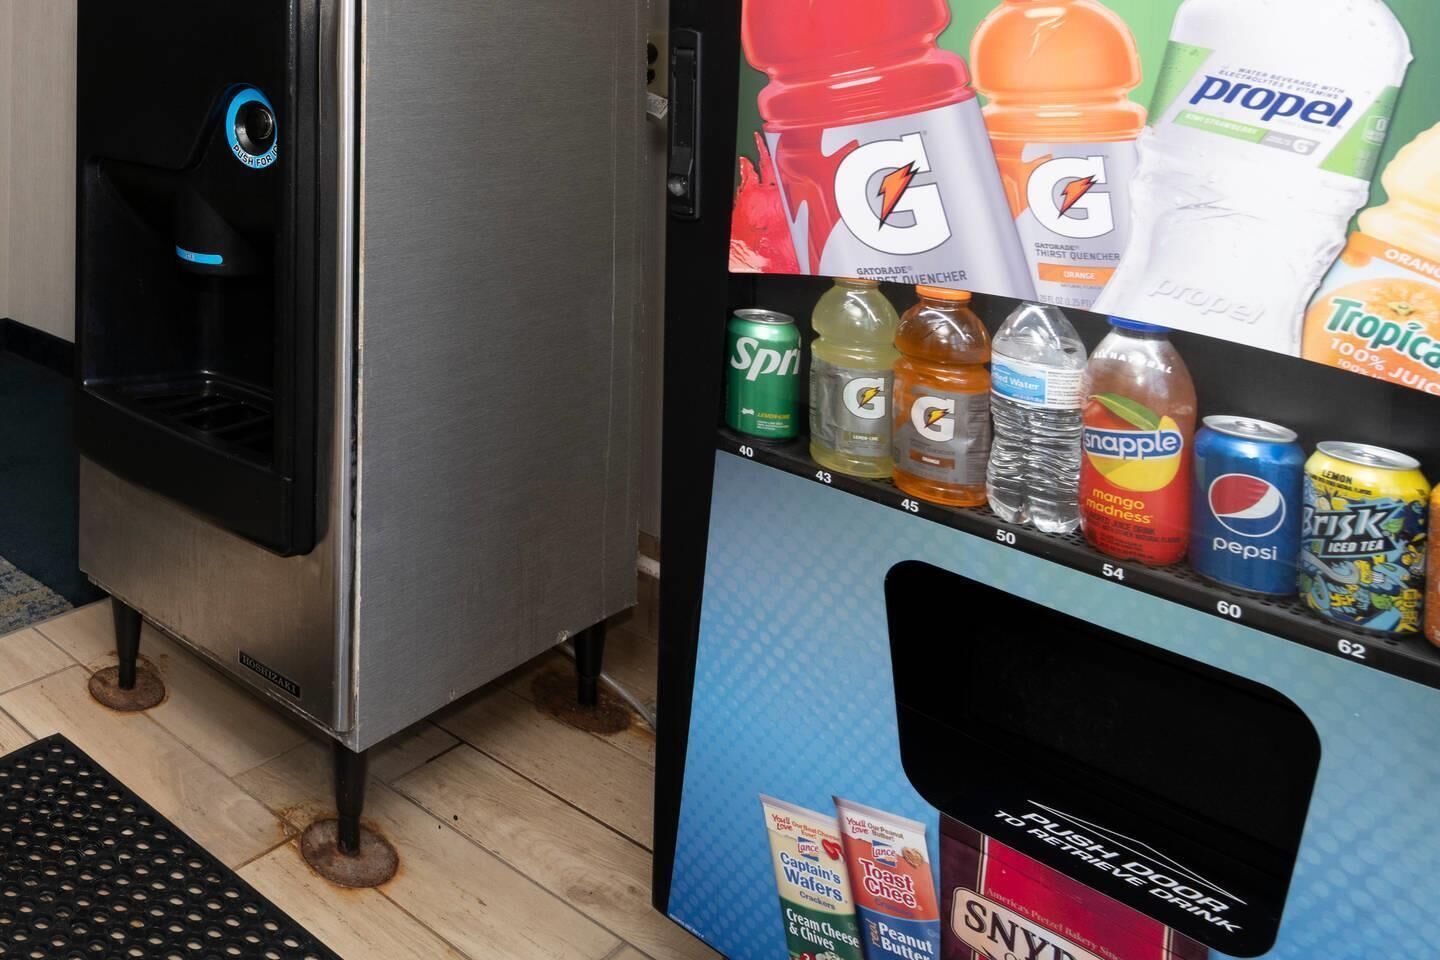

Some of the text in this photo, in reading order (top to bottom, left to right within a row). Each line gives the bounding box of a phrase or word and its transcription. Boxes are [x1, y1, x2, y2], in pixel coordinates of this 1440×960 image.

[1218, 69, 1286, 89] ELECTROLYTES
[1295, 86, 1339, 100] VITAMINS
[1238, 67, 1345, 93] WATER BEVERAGE WITH
[1189, 75, 1353, 128] propel
[233, 144, 272, 167] PUSH FOR
[835, 132, 952, 255] G
[1026, 155, 1115, 239] G
[1034, 242, 1075, 251] GATORADE
[1036, 249, 1120, 261] THIRST QUENCHER
[856, 266, 908, 276] GATORADE
[903, 270, 968, 284] QUENCHER
[1064, 271, 1095, 280] ORANGE
[1147, 280, 1266, 325] propel
[1327, 298, 1440, 369] Tropica
[730, 336, 800, 381] Spri
[1109, 351, 1172, 374] NARAL
[1331, 338, 1387, 371] 100%
[1010, 378, 1039, 390] Water
[843, 377, 886, 419] G
[911, 396, 955, 442] G
[739, 445, 753, 457] 40
[1085, 430, 1177, 460] snapple
[815, 470, 832, 484] 43
[1322, 469, 1353, 485] LEMON
[901, 499, 920, 513] 45
[1092, 488, 1145, 510] mango
[1086, 499, 1152, 524] madness
[996, 530, 1015, 545] 50
[1213, 537, 1277, 560] pepsi
[1328, 539, 1385, 552] ICED TEA
[1102, 563, 1125, 580] 54
[1217, 600, 1242, 618] 60
[1337, 639, 1366, 659] 62
[242, 654, 297, 694] HOSHIZAKI
[771, 814, 791, 825] You'll
[776, 822, 793, 832] Love
[846, 817, 866, 828] You'll
[851, 826, 869, 835] Love
[868, 823, 904, 840] Our Peanut
[797, 843, 819, 854] Lance
[872, 846, 896, 858] Lance
[780, 852, 841, 884] Captain's
[994, 810, 1243, 933] TO RETRIEVE DRINK
[1021, 812, 1230, 913] PUSH DOOR
[784, 867, 842, 902] Wafers
[859, 858, 913, 891] Toast
[799, 891, 836, 910] Crackers
[864, 878, 916, 908] Chee
[786, 908, 860, 948] Cream Cheese
[987, 888, 1030, 916] America's
[1030, 910, 1064, 933] Pretzel
[1065, 927, 1097, 949] Bakery
[789, 923, 835, 951] & Chives
[878, 922, 934, 954] Peanut
[881, 938, 930, 960] Butter
